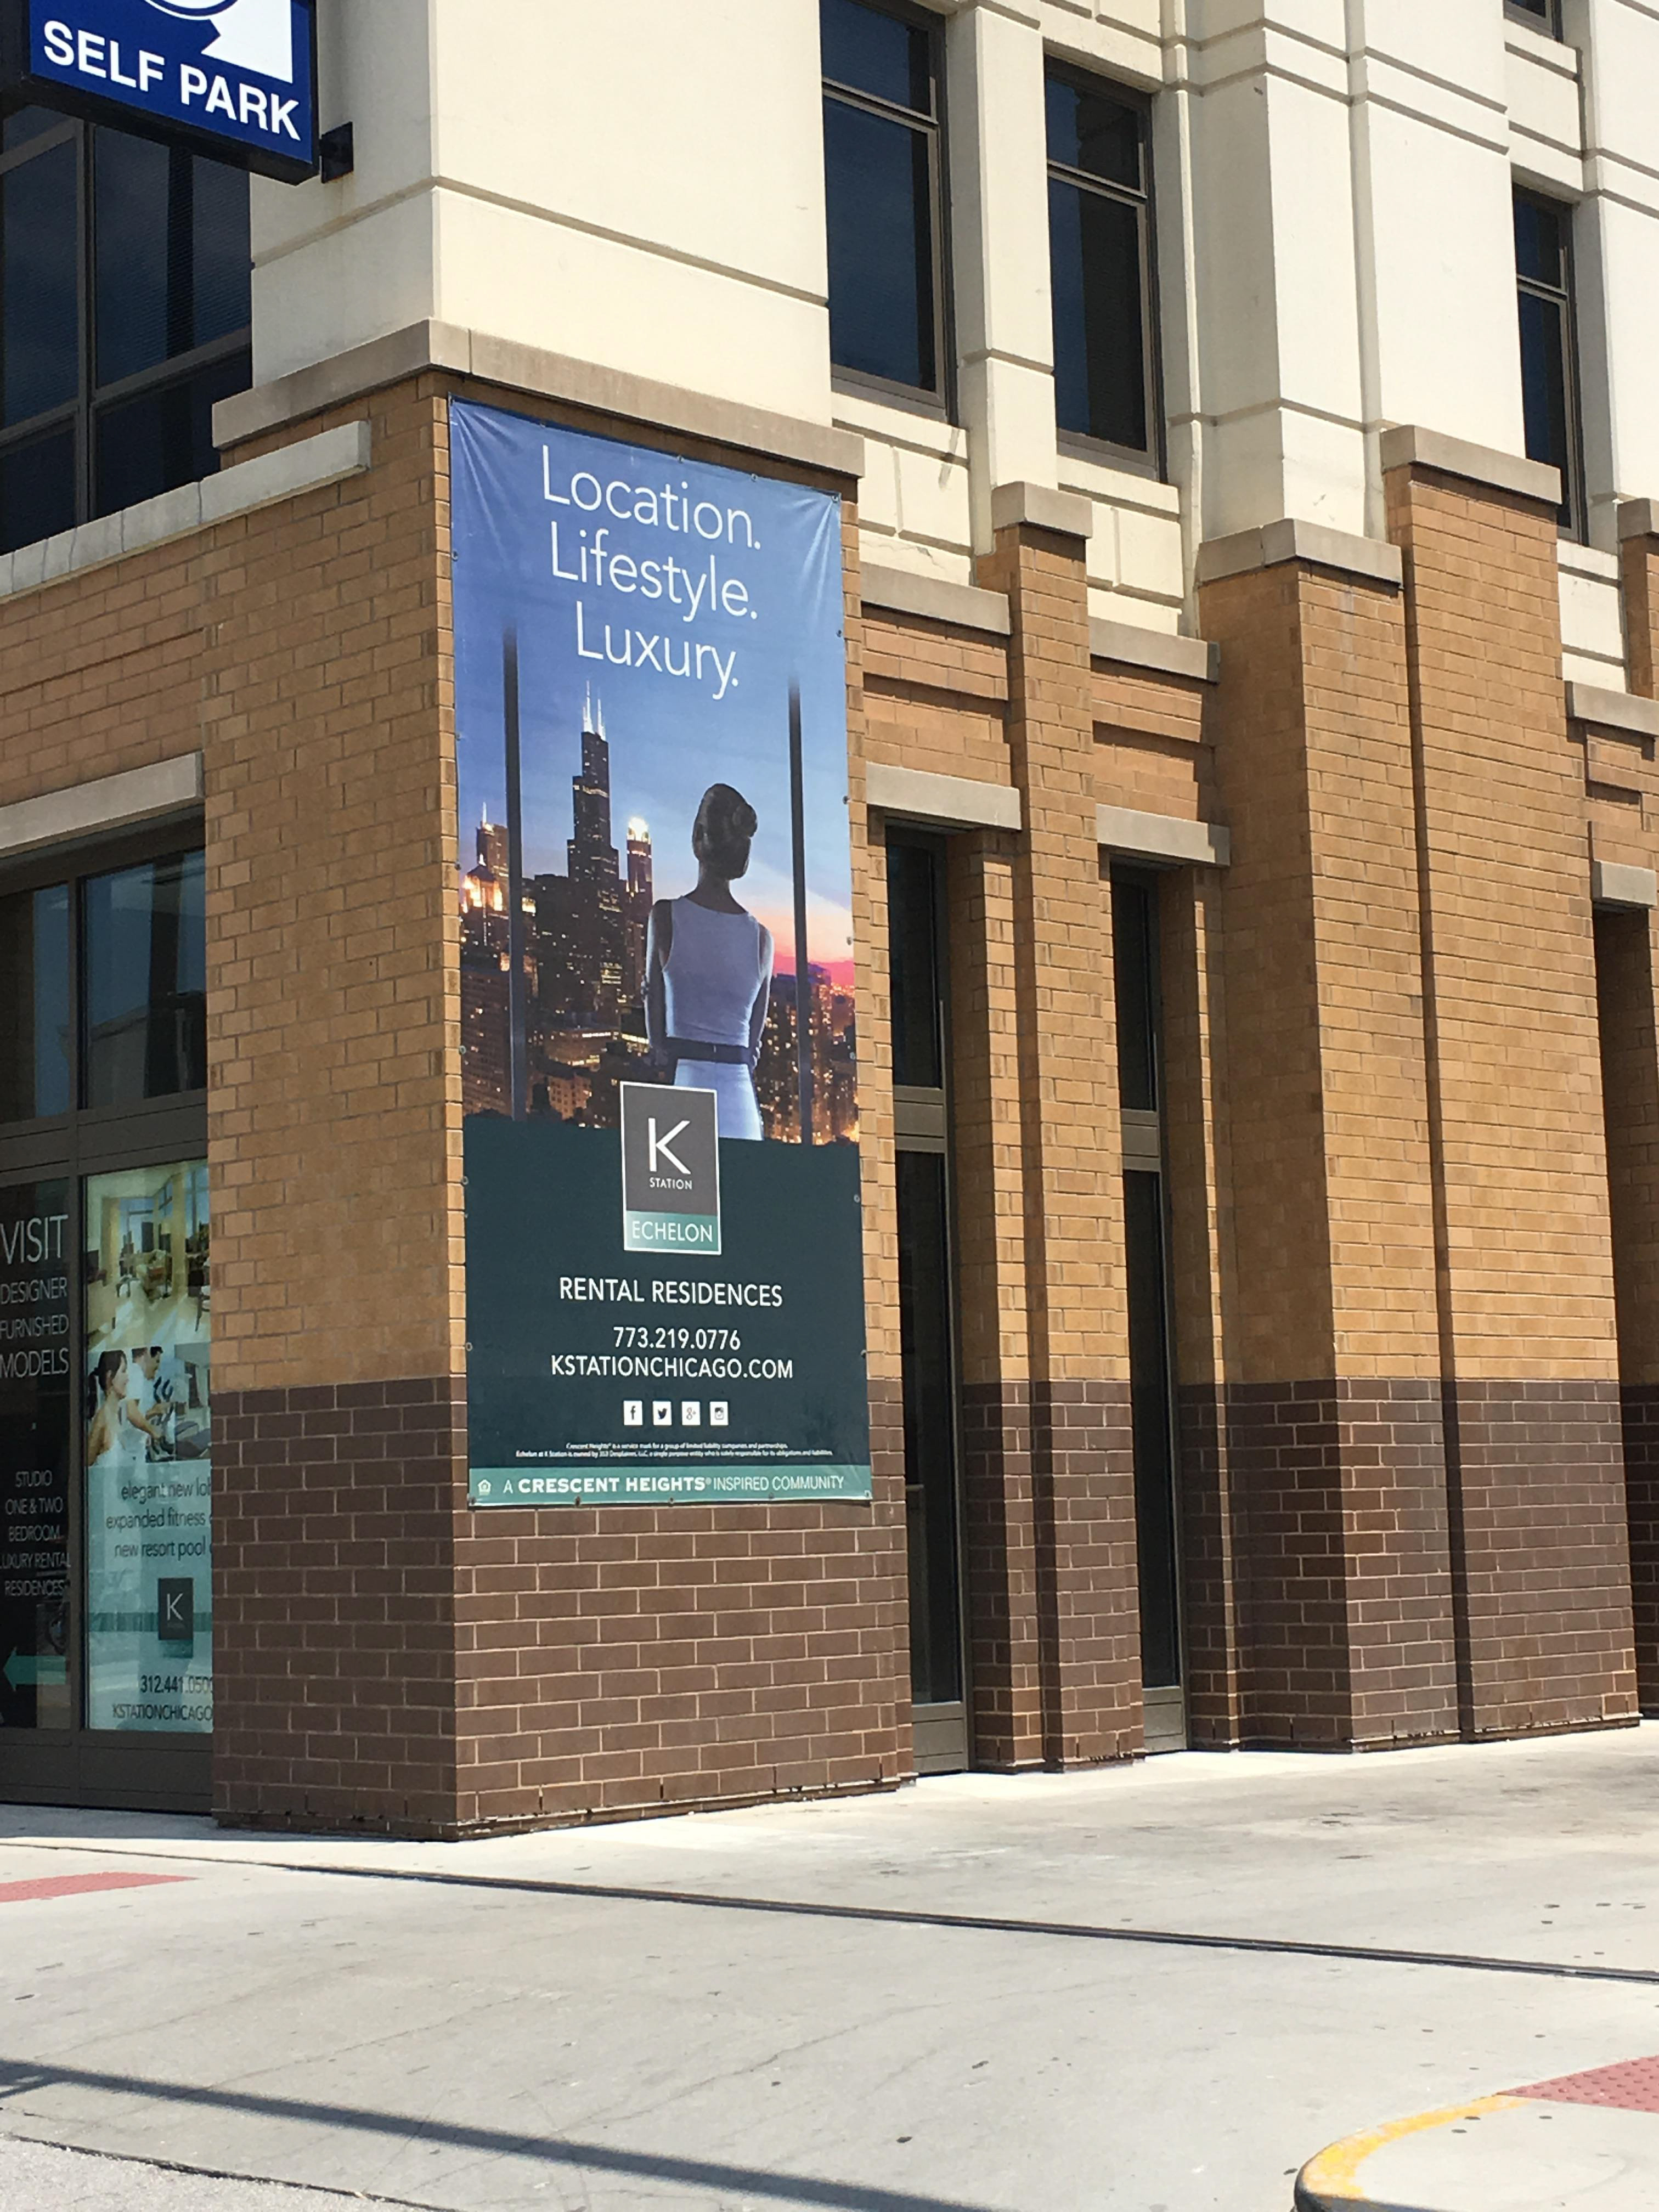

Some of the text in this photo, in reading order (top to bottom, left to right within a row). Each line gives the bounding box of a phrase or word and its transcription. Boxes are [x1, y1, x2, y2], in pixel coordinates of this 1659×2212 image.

[44, 20, 301, 141] SELF PARK
[543, 445, 761, 550] Location.
[551, 521, 758, 622] Lifestyle.
[577, 601, 738, 699] Luxury.
[648, 1118, 691, 1175] K
[650, 1177, 692, 1190] STATION
[0, 1215, 69, 1265] VISIT
[632, 1221, 713, 1242] ECHELON
[1, 1277, 67, 1305] DESIGNER
[560, 1277, 783, 1307] RENTAL RESIDENCES
[0, 1314, 69, 1339] FURNISHED
[613, 1327, 741, 1350] 773.219.0776
[0, 1347, 69, 1378] MODELS
[551, 1355, 793, 1379] KSTATIONCHICAGO.COM
[15, 1470, 53, 1487] STUDIO
[503, 1480, 513, 1493] A
[518, 1477, 619, 1493] CRESCENT
[713, 1476, 768, 1491] INSPIRED
[772, 1476, 844, 1490] COMMUNITY
[121, 1481, 166, 1504] elegant
[168, 1483, 193, 1497] new
[5, 1497, 63, 1515] ONE & TWO
[106, 1508, 164, 1533] expanded
[168, 1507, 206, 1526] fitness
[9, 1525, 60, 1542] BEDROOM
[35, 1552, 71, 1569] RENTAL
[115, 1544, 138, 1558] new
[142, 1542, 175, 1557] resort
[178, 1535, 206, 1561] pool
[4, 1580, 64, 1596] RESIDENCES
[167, 1593, 183, 1621] K
